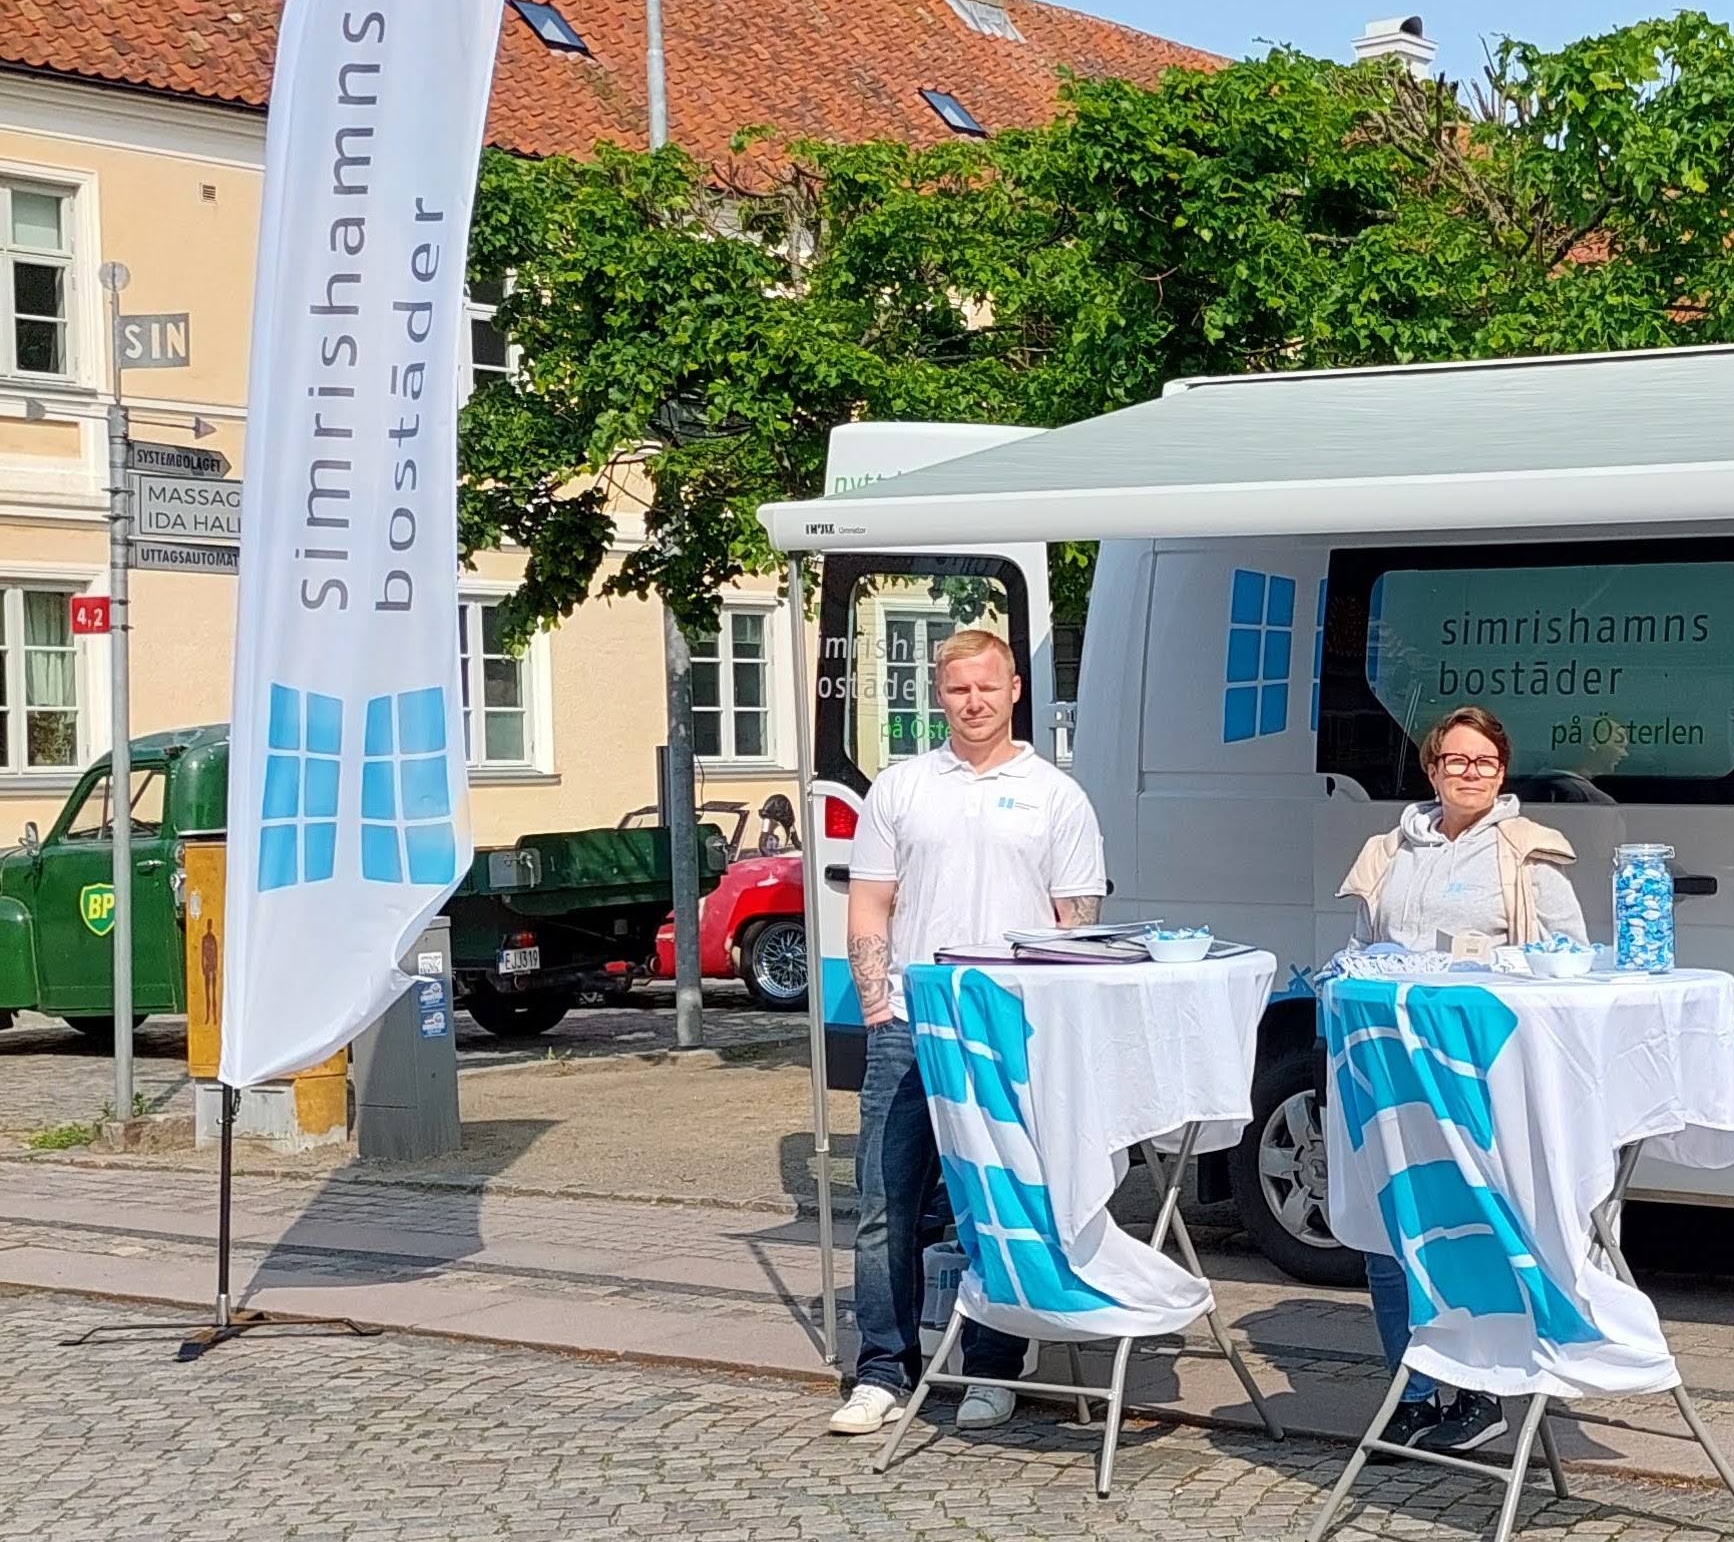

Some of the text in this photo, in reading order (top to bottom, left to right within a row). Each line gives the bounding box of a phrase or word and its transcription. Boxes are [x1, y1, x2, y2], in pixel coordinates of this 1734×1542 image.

[295, 11, 386, 611] simrishamns
[124, 322, 186, 359] SIN
[136, 448, 222, 473] SYSTEMBOLAGET
[148, 511, 187, 531] IDA
[1441, 608, 1709, 646] simrishamns
[1551, 712, 1704, 751] på Österlen
[88, 892, 115, 919] BP
